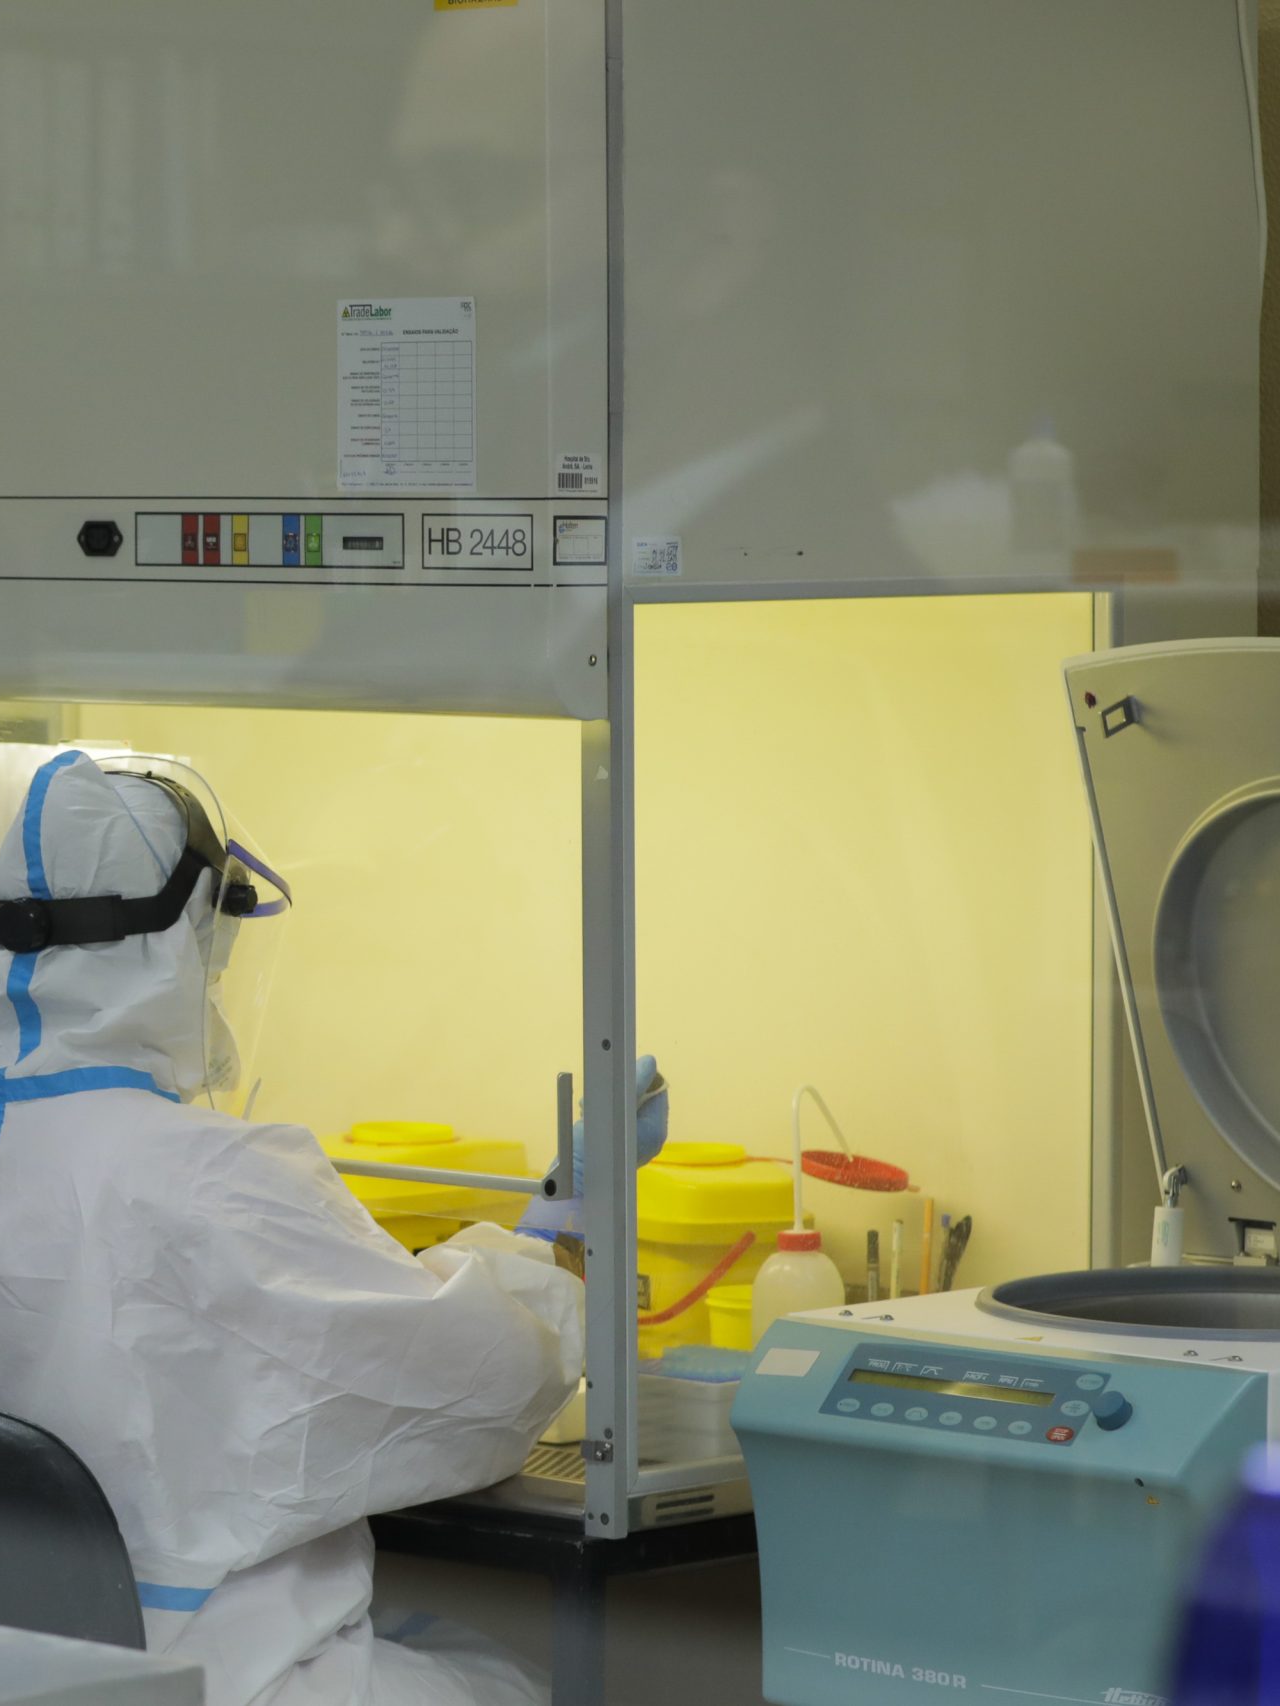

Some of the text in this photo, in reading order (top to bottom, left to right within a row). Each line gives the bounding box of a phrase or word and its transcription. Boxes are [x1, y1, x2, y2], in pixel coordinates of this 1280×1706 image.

[428, 528, 462, 556] HB
[470, 528, 527, 557] 2448
[834, 1651, 905, 1679] ROTINA
